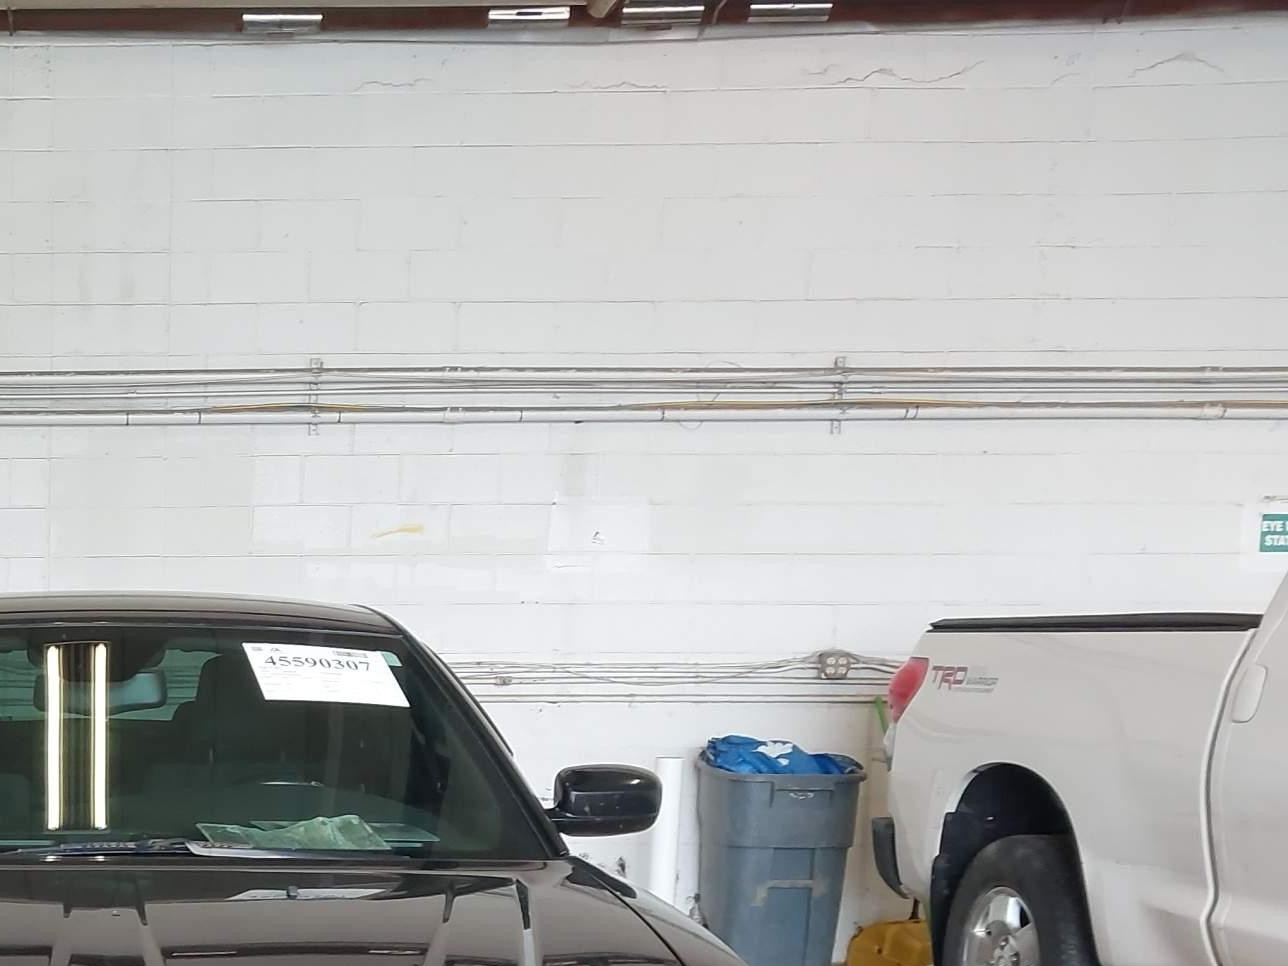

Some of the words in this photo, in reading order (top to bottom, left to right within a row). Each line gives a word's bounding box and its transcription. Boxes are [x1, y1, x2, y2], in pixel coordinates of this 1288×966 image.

[1262, 520, 1285, 532] EYE
[264, 655, 371, 672] 45590307
[932, 665, 969, 690] TRD
